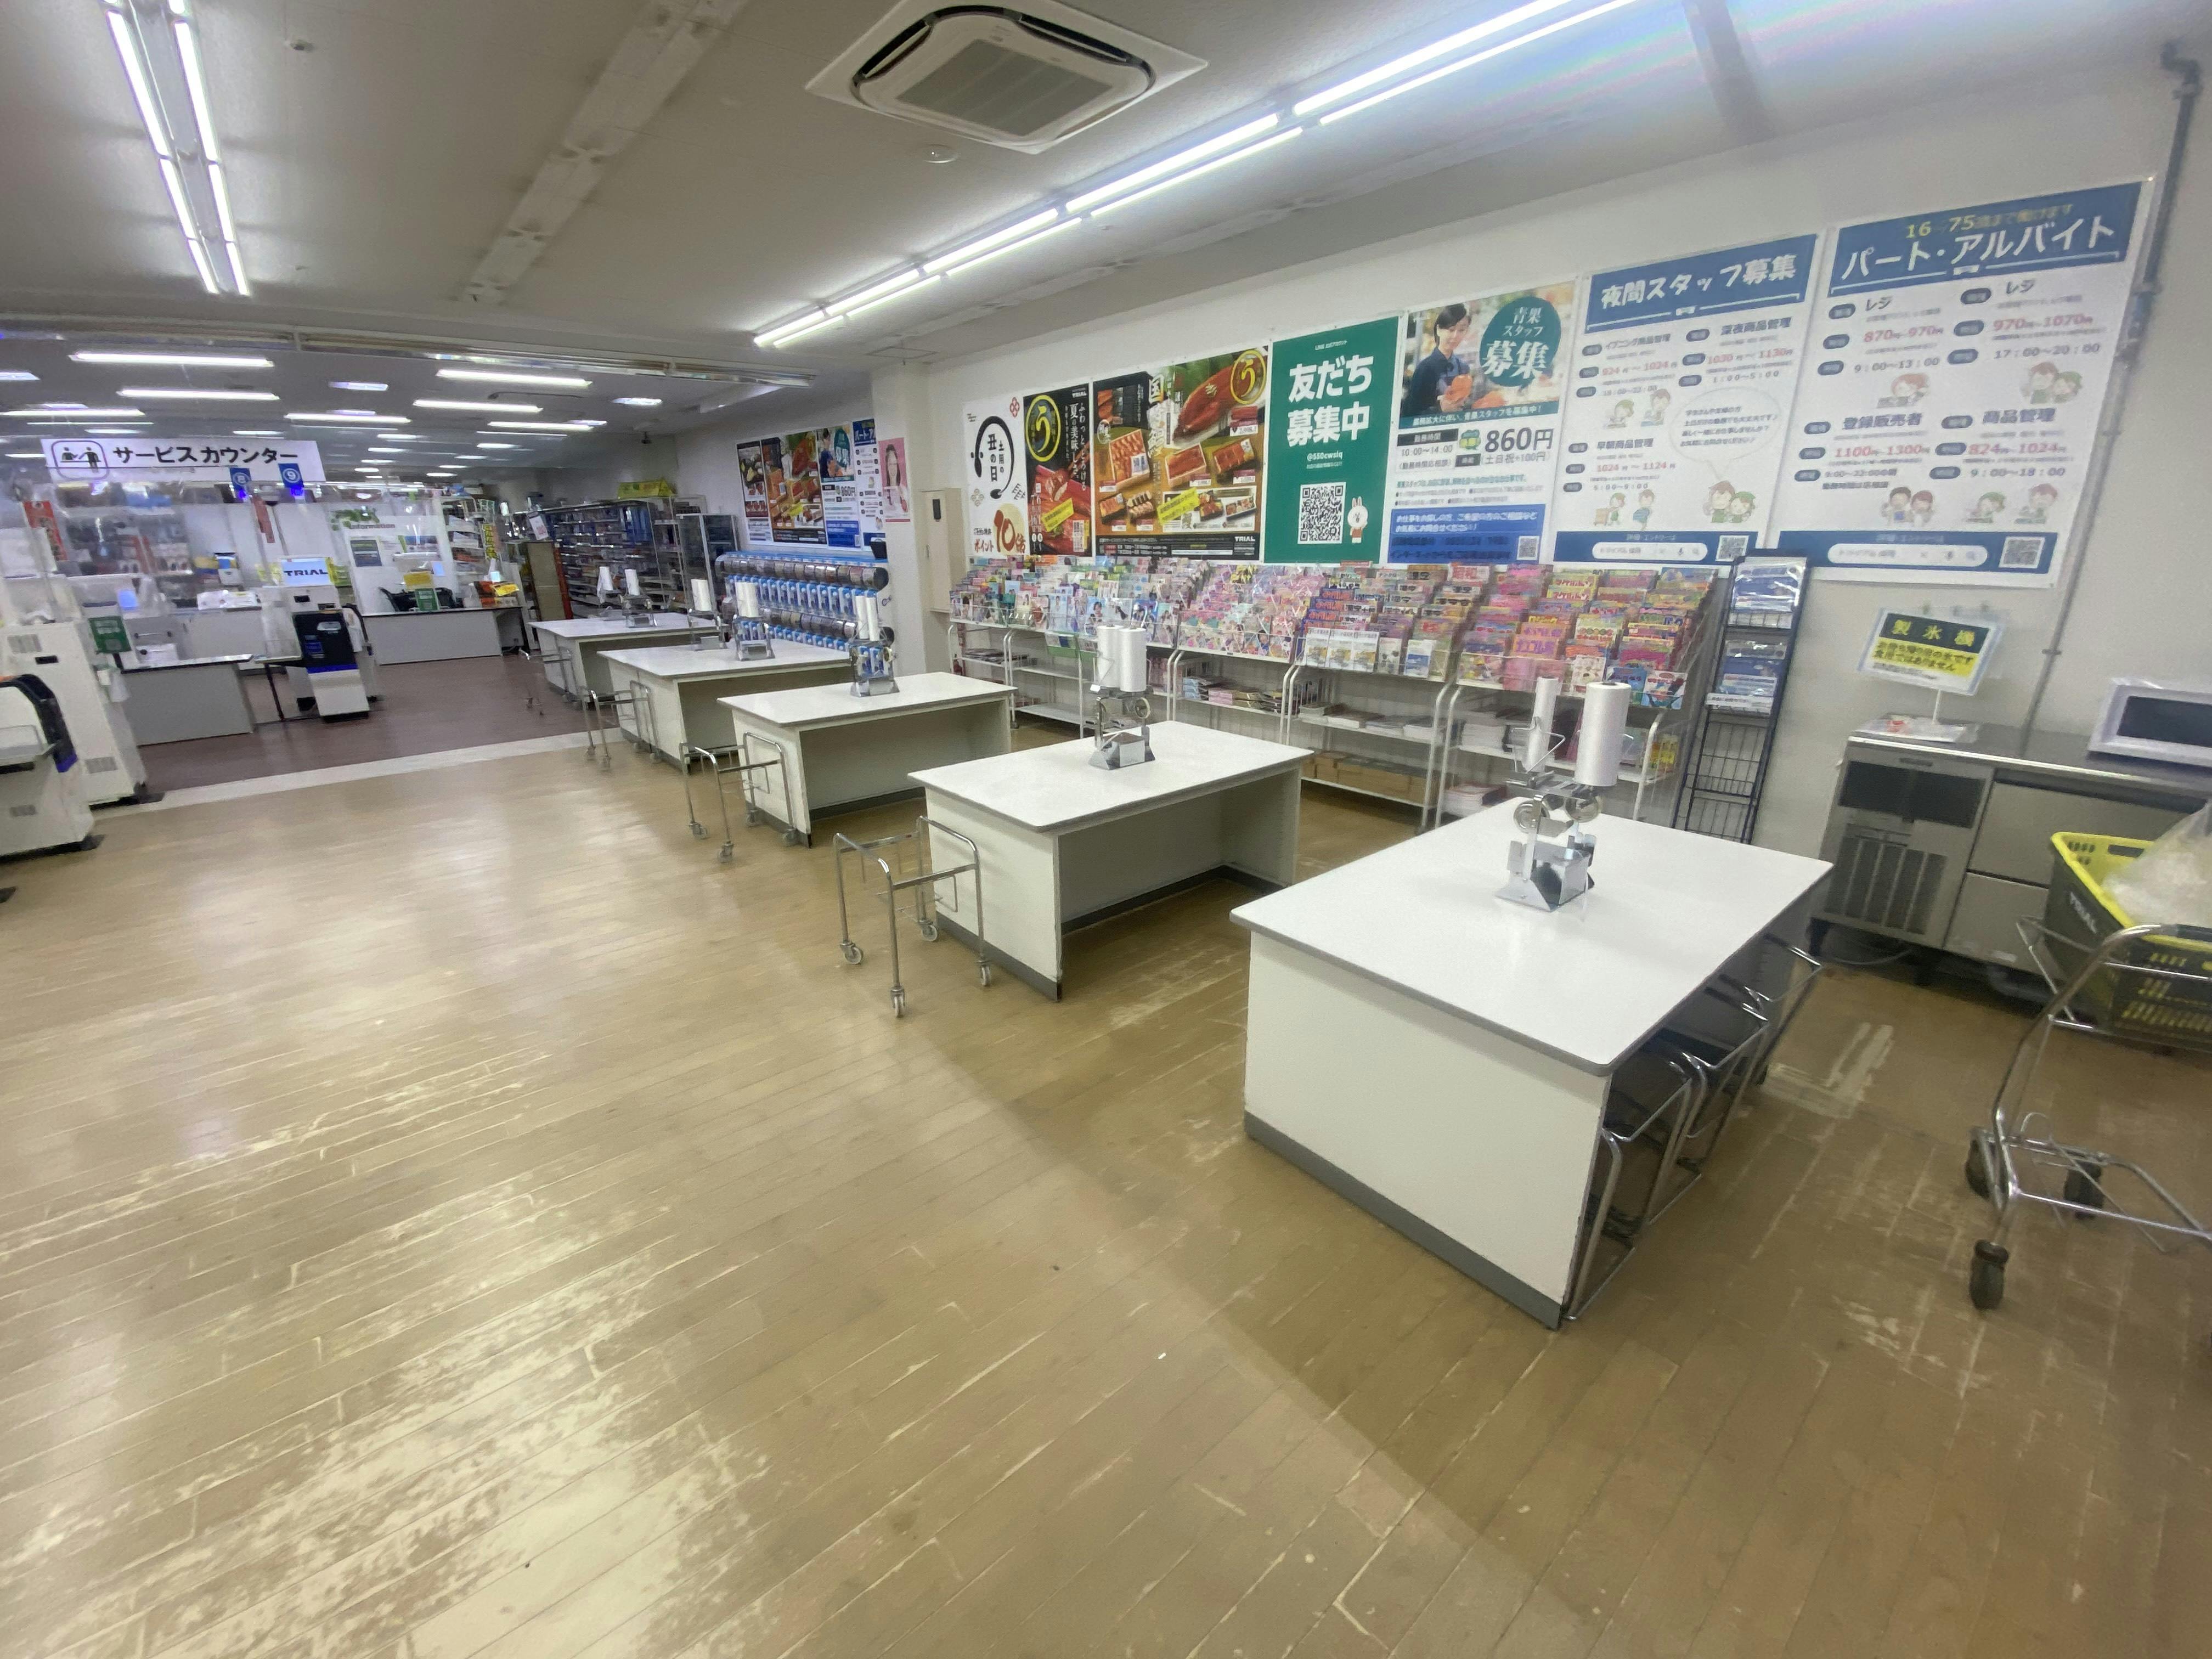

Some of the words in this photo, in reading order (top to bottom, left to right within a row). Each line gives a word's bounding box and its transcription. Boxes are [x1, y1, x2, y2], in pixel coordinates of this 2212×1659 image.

[1842, 215, 2114, 280] パート・アルバイト
[1601, 254, 1797, 309] 夜間スタッフ募集
[2006, 278, 2037, 295] レジ
[1865, 296, 1893, 312] レジ
[1502, 325, 1544, 337] スタッフ
[1482, 340, 1549, 379] 募集
[1288, 354, 1374, 403] 友だち
[1287, 400, 1370, 447] 募集中
[1485, 427, 1554, 453] 860円
[113, 446, 298, 465] サービスカウンター
[284, 569, 329, 577] TRIAL
